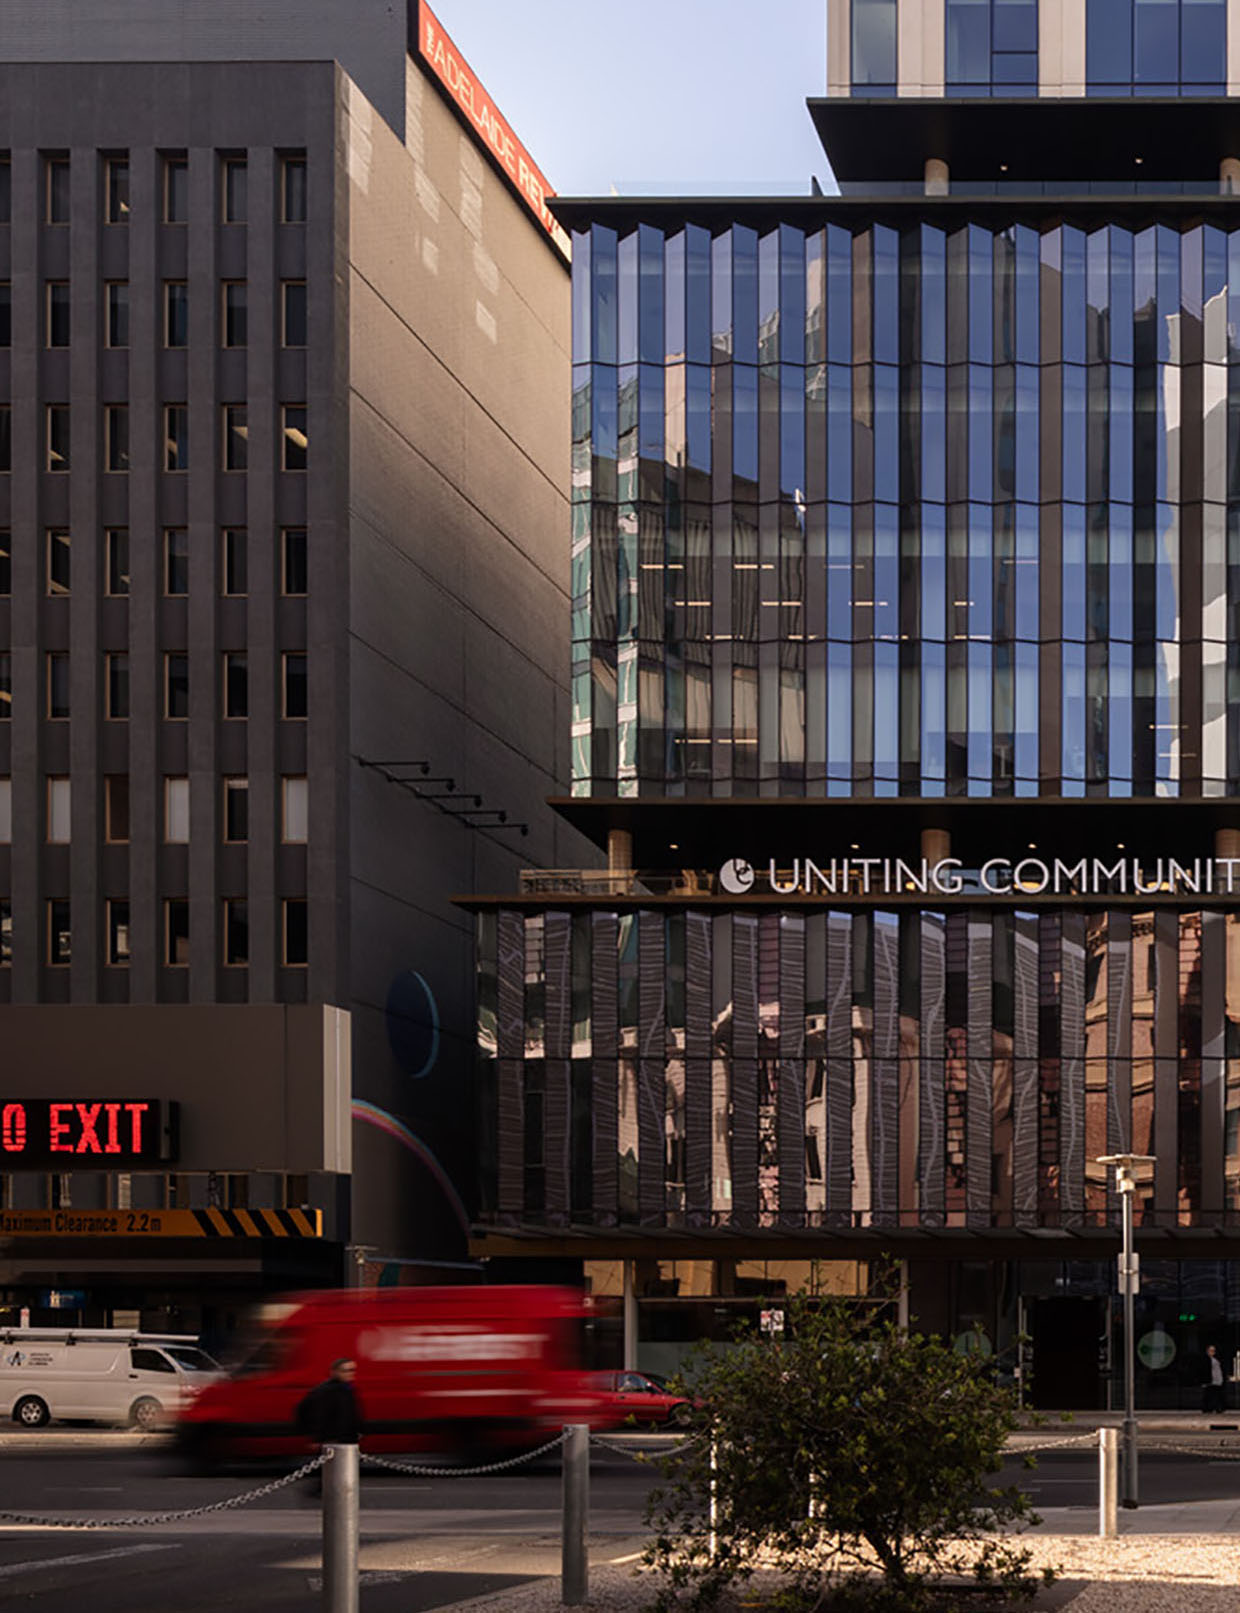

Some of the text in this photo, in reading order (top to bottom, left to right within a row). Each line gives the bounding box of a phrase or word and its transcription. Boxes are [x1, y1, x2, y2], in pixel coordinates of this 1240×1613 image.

[433, 39, 516, 174] ADELAIDE
[769, 857, 964, 893] UNITING
[50, 1103, 148, 1154] EXIT
[55, 1213, 118, 1232] Clearance
